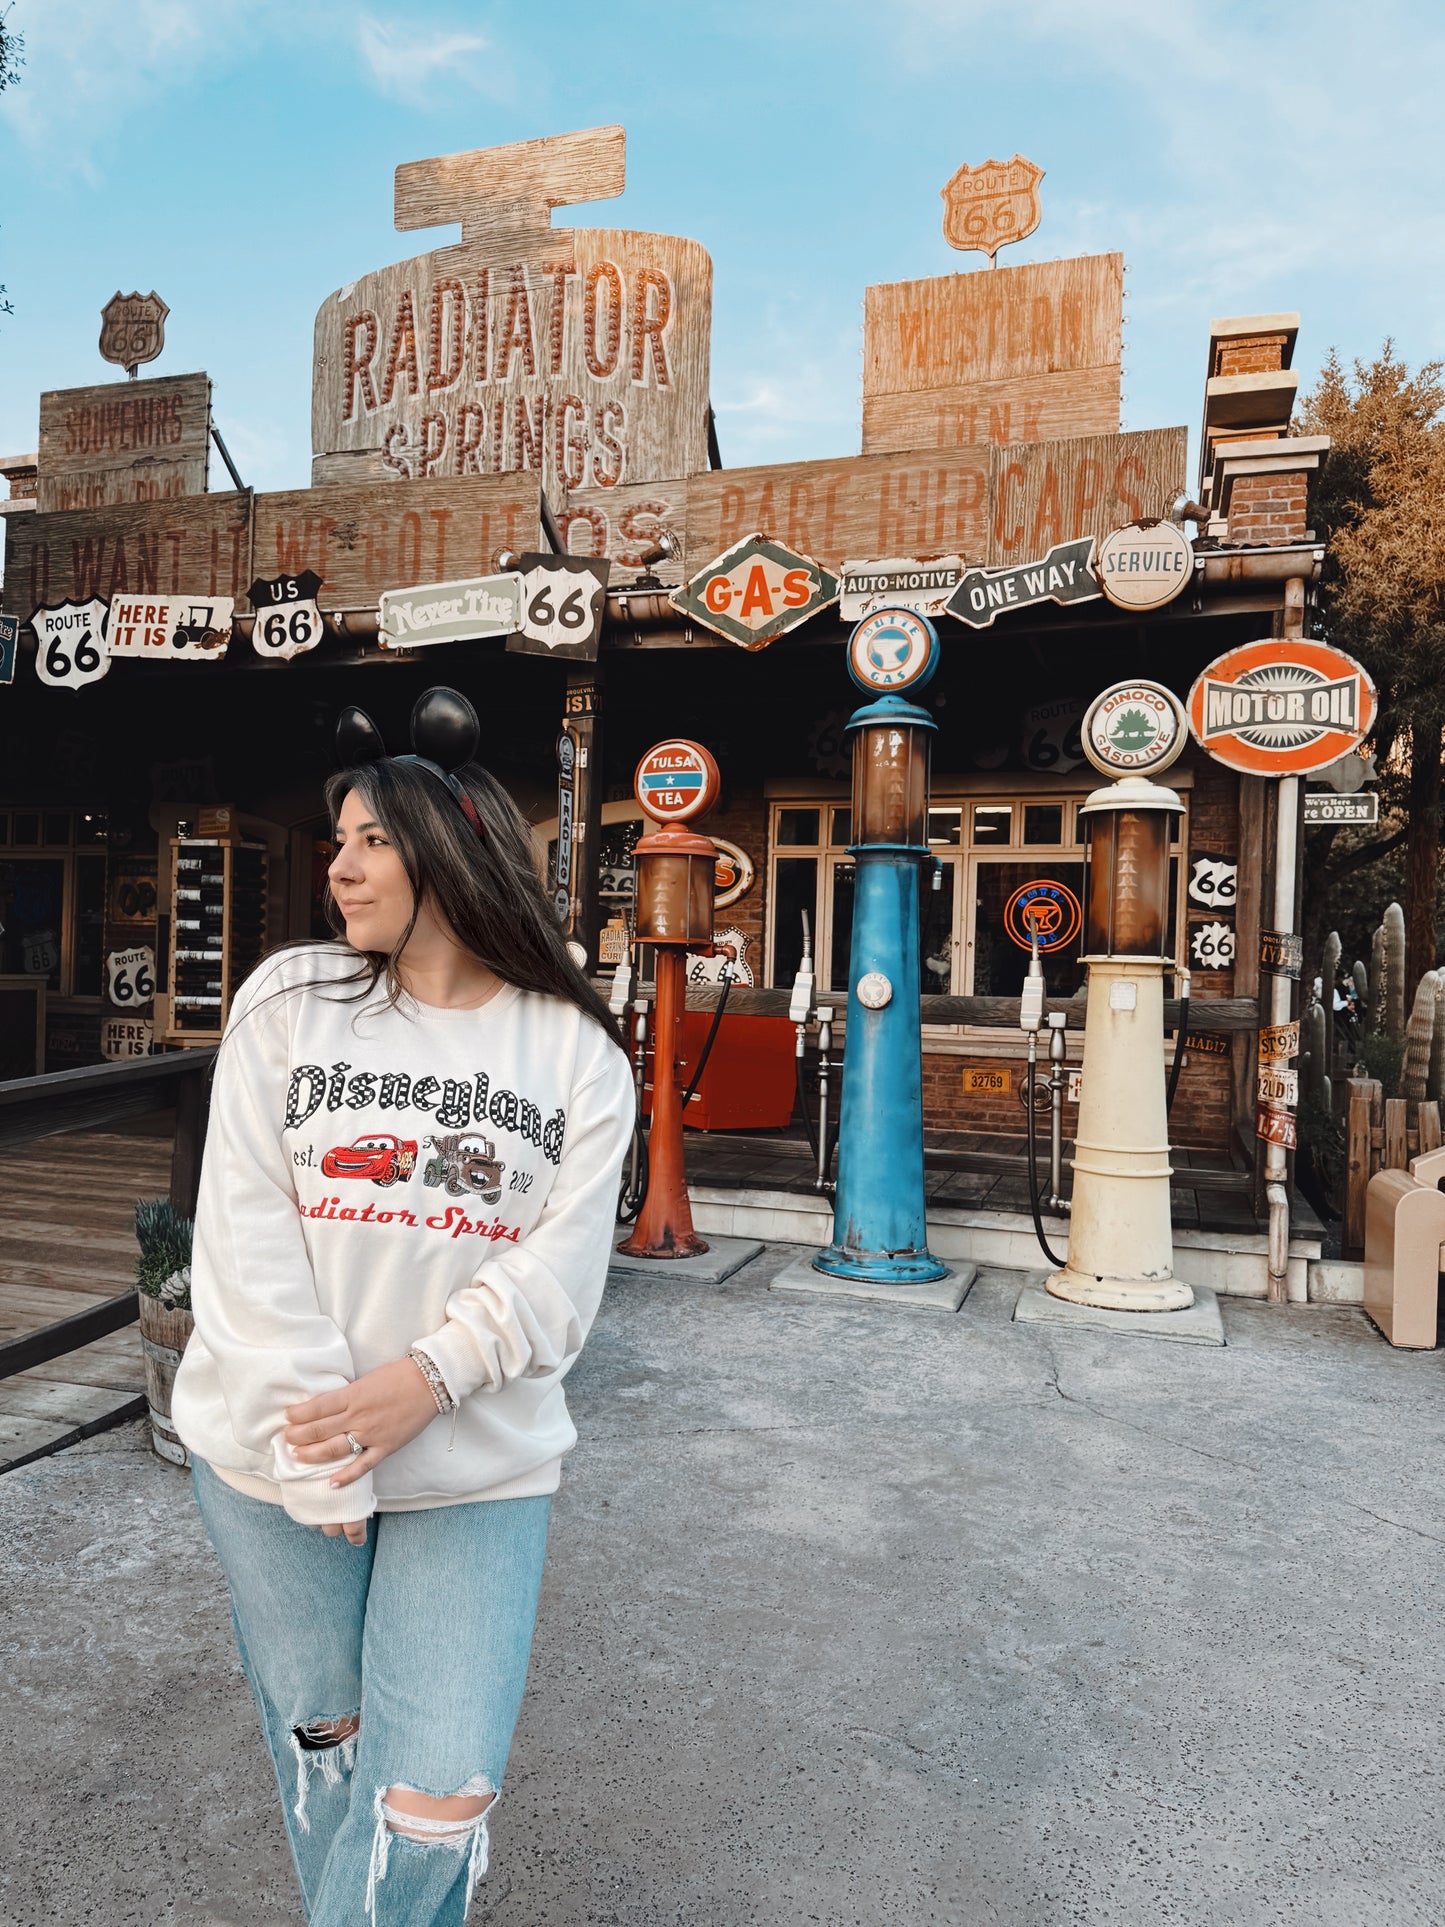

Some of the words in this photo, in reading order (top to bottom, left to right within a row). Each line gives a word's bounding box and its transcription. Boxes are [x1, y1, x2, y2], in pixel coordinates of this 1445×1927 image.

[962, 171, 1019, 193] ROUTE
[964, 200, 1016, 235] 66
[115, 306, 152, 317] ROUTE
[112, 326, 147, 352] 66
[899, 290, 1083, 368] WESTERN
[342, 261, 676, 424] RADIATOR
[65, 393, 184, 454] SOUVENIRS
[383, 393, 628, 490] SPRINGS
[719, 475, 849, 560] RARE
[996, 455, 1146, 551] CAPS
[72, 528, 187, 600] WANT
[209, 523, 247, 596] IT
[365, 510, 452, 588] GOT
[1106, 552, 1183, 573] SERVICE
[270, 580, 299, 601] US
[705, 565, 812, 617] G-A-S
[847, 568, 957, 592] AUTO-MOTIVE
[969, 578, 1018, 611] ONE
[1022, 560, 1076, 596] WAY
[118, 604, 169, 625] HERE
[389, 600, 463, 635] Never
[463, 588, 513, 625] Tire
[528, 585, 586, 629] 66
[45, 613, 91, 633] ROUTE
[264, 609, 312, 648] 66
[115, 628, 140, 646] IT
[144, 627, 166, 646] IS
[46, 631, 100, 677] 66
[870, 671, 906, 683] GAS
[1103, 691, 1166, 714] DINOCO
[1209, 690, 1306, 728] MOTOR
[1311, 687, 1354, 725] OIL
[1096, 731, 1170, 765] GASOLINE
[652, 756, 692, 769] TULSA
[657, 792, 684, 805] TEA
[1322, 805, 1369, 819] OPEN
[560, 793, 571, 880] TRADING
[1197, 870, 1236, 897] 66
[1200, 933, 1233, 956] 66
[115, 952, 147, 966] ROUTE
[114, 965, 156, 1001] 66
[108, 1025, 145, 1040] HERE
[107, 1041, 122, 1055] IT
[128, 1041, 144, 1055] IS
[971, 1076, 1003, 1088] 32769
[283, 1062, 566, 1165] Disneyland
[293, 1144, 318, 1168] est.
[508, 1170, 534, 1194] 2012
[299, 1197, 419, 1227] adiator
